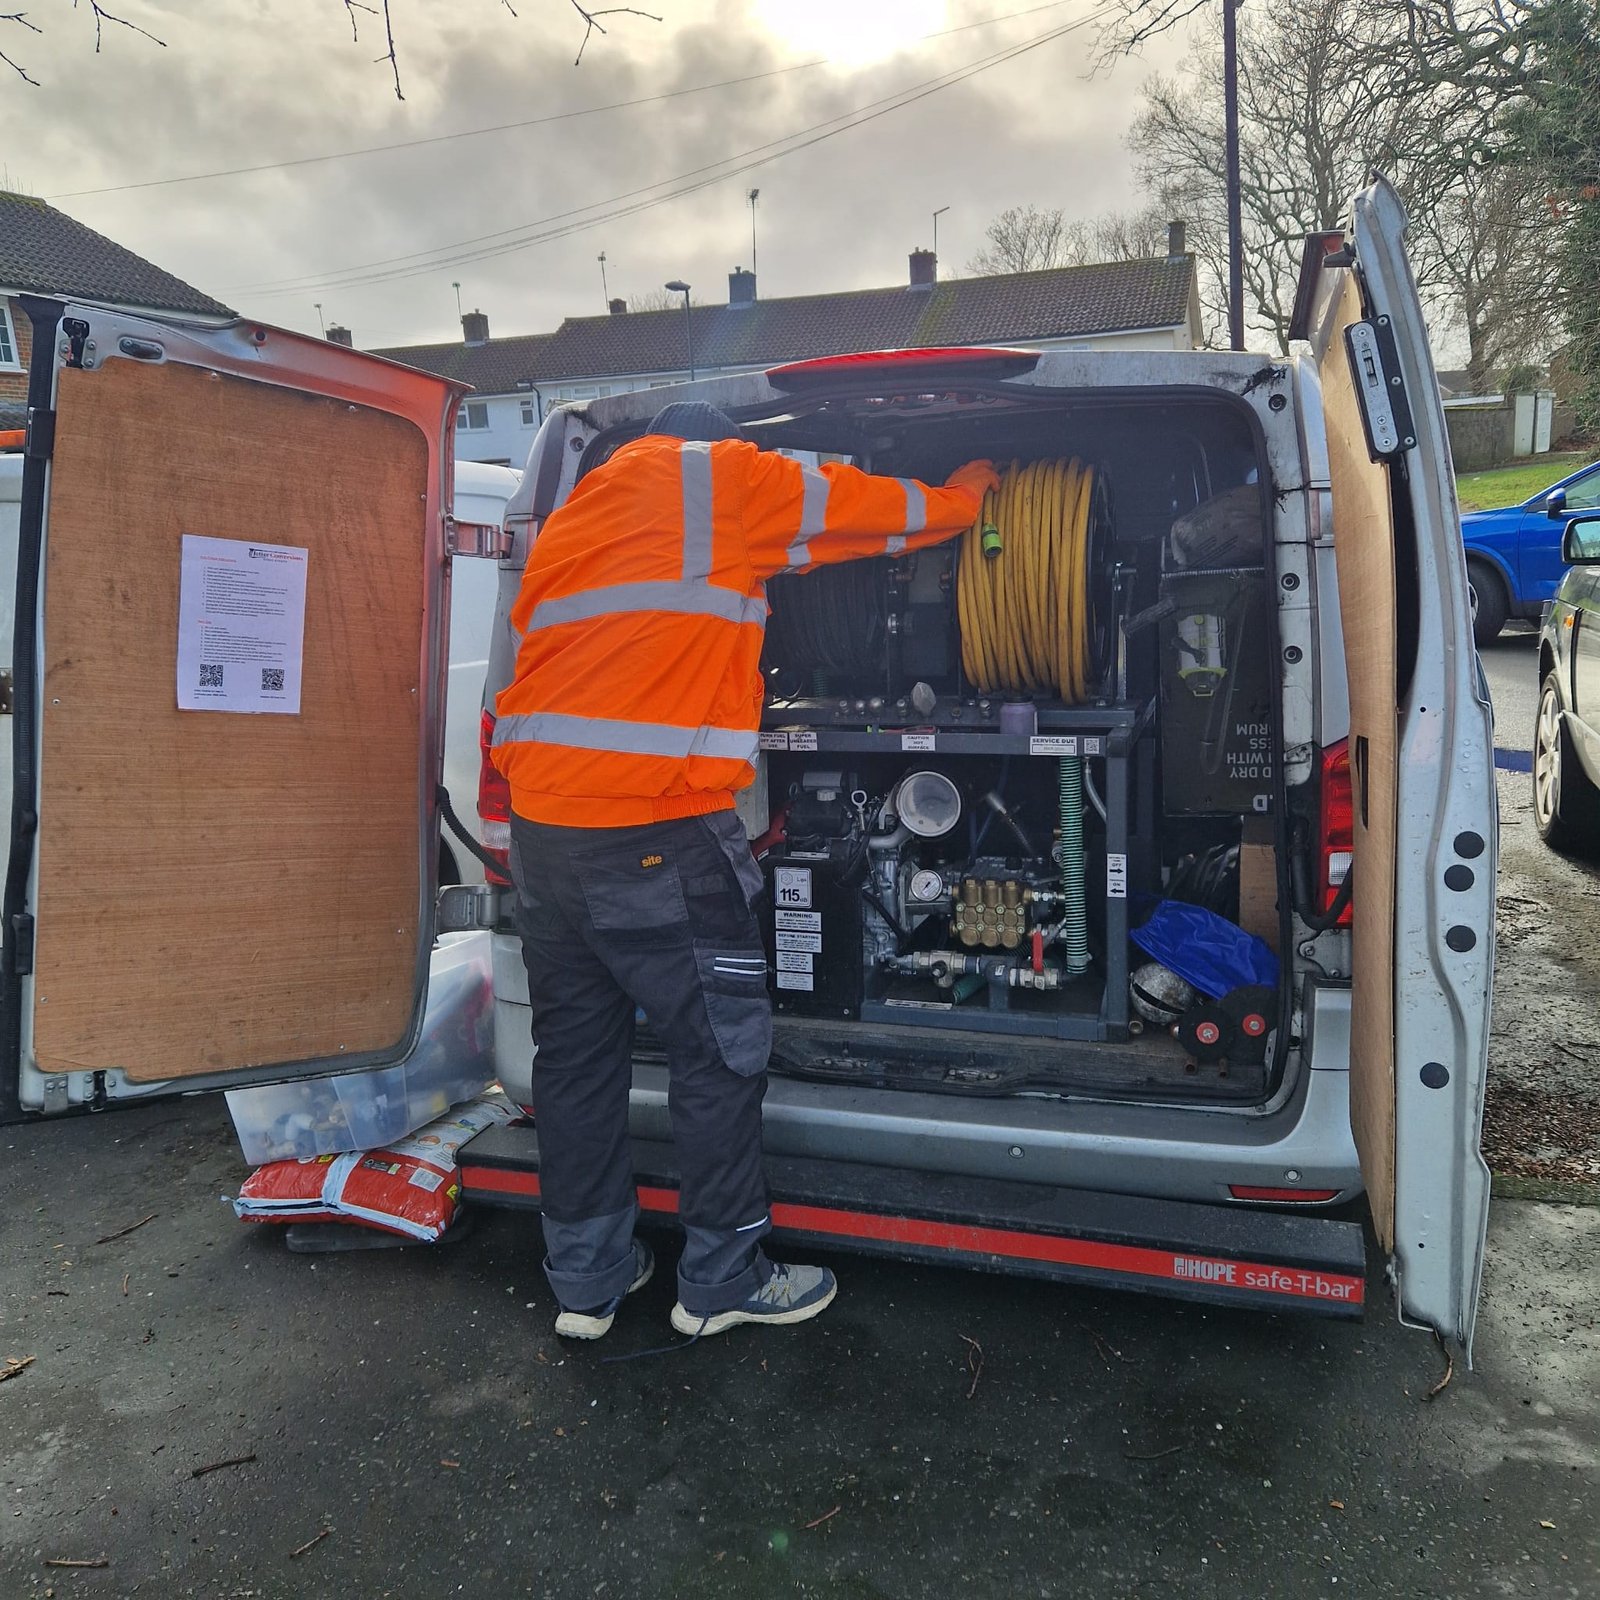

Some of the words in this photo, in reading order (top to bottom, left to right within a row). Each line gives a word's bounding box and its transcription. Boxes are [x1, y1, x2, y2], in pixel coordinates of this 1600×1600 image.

[1236, 724, 1272, 735] RUM
[1227, 753, 1264, 764] WITH
[1230, 767, 1258, 778] DRY
[641, 855, 663, 867] site
[780, 887, 800, 902] 115
[1188, 1258, 1237, 1284] HOPE
[1244, 1270, 1355, 1299] safe-T-bar
